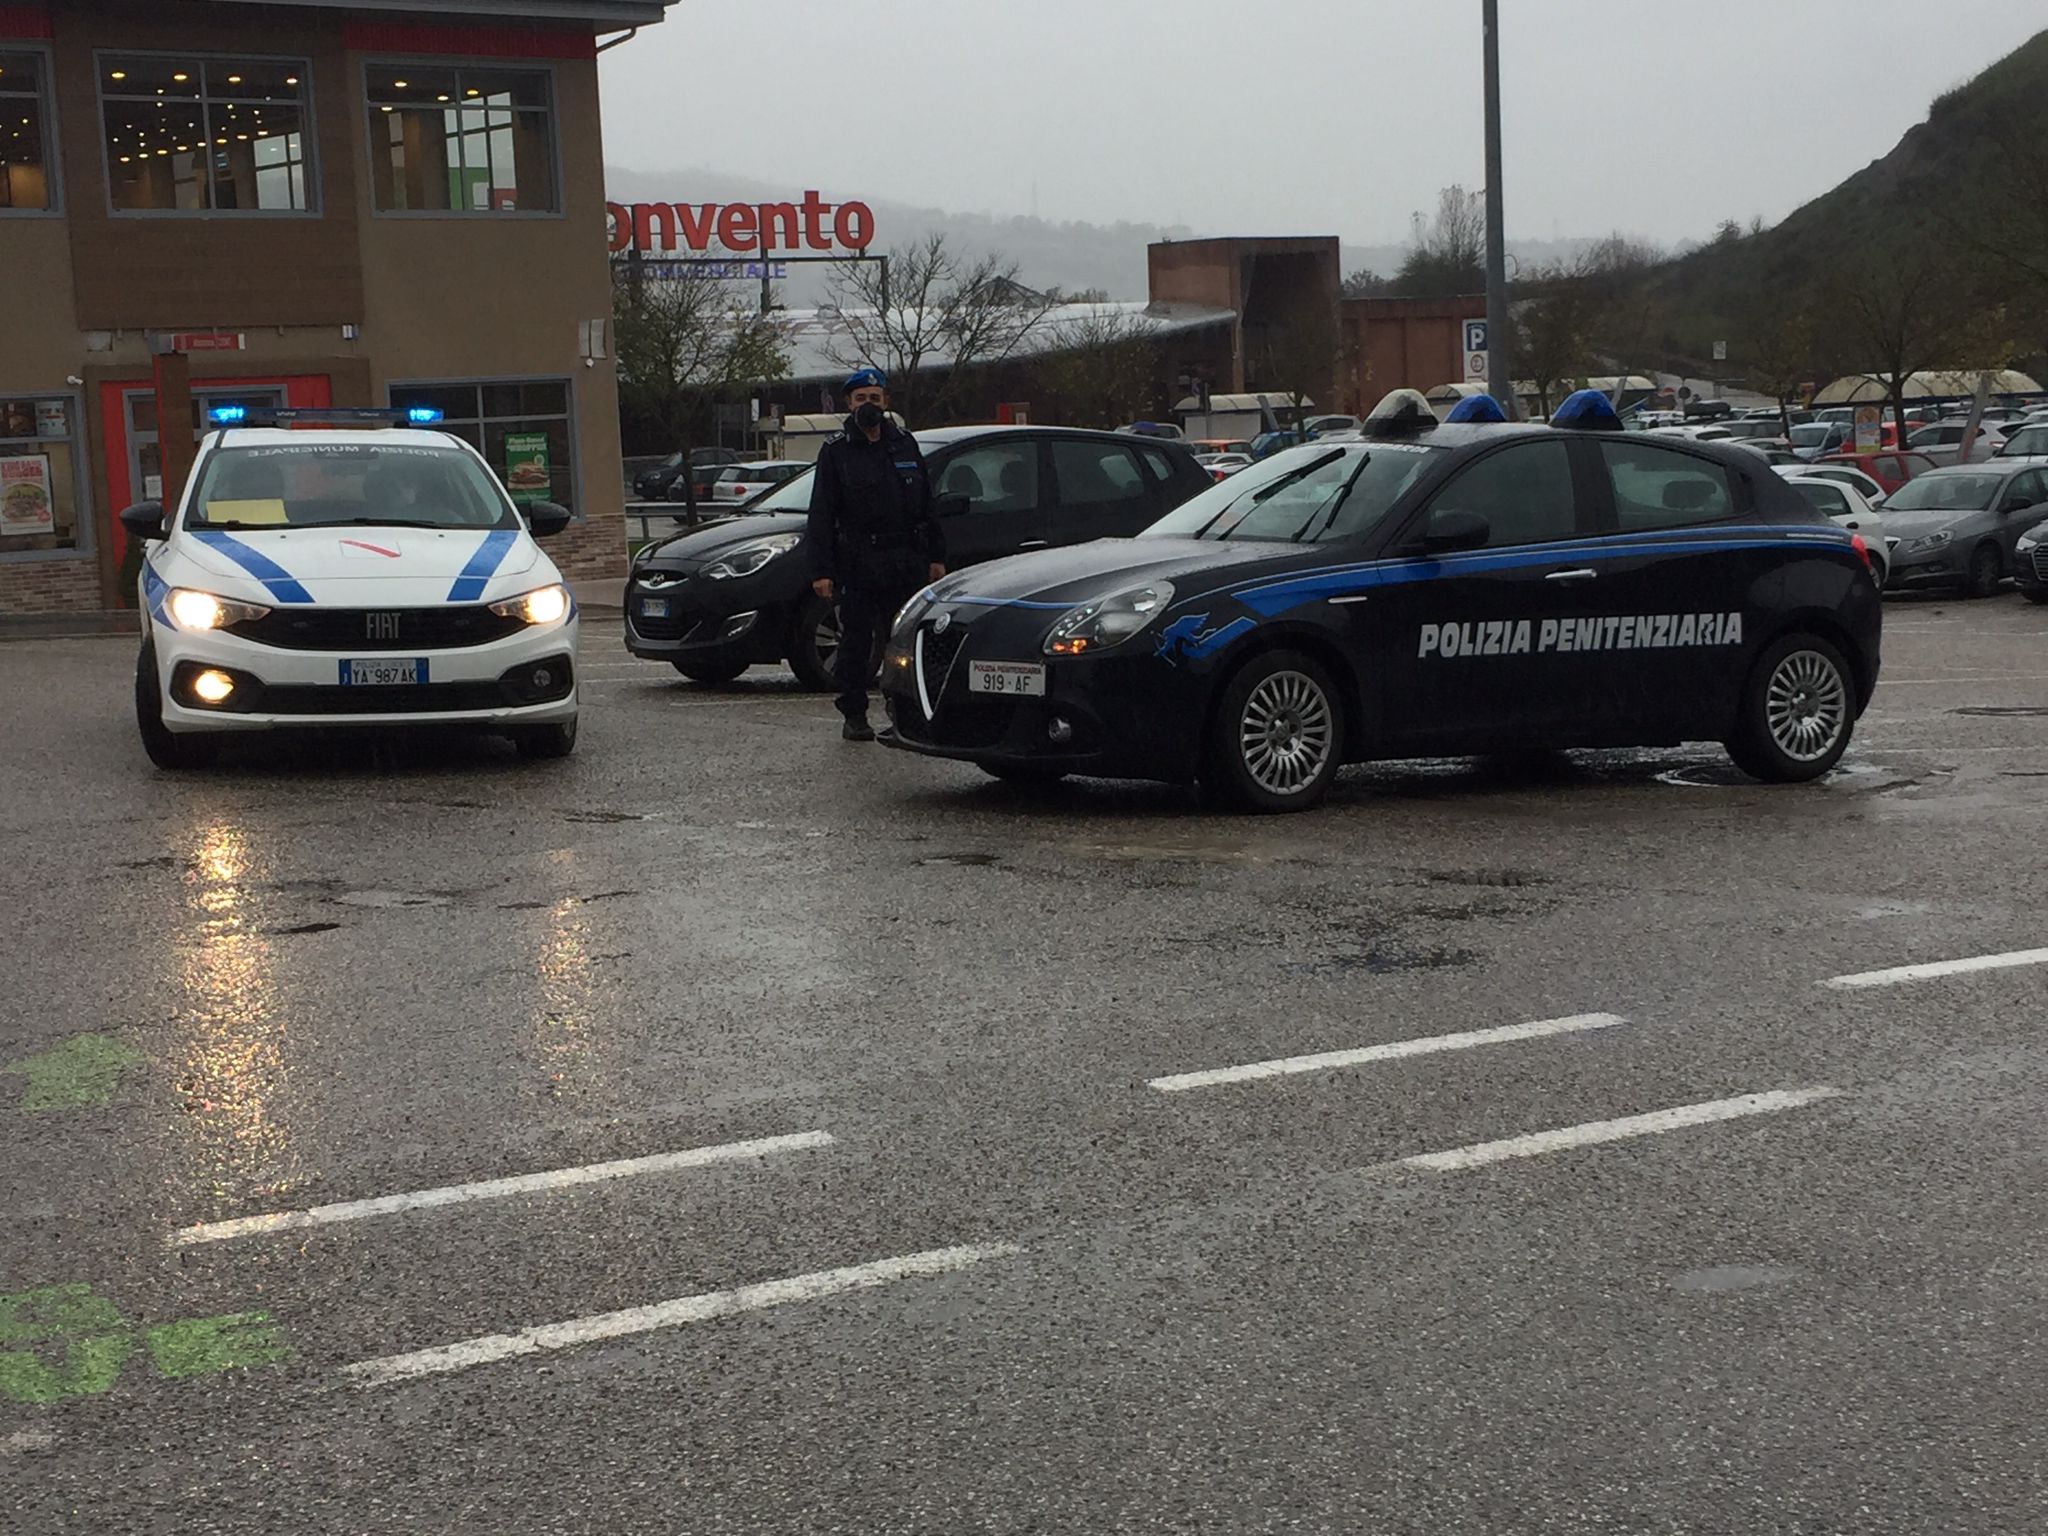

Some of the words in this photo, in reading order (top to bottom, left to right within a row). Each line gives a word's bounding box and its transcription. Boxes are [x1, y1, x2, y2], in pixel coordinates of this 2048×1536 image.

[607, 190, 875, 251] onvento
[1471, 329, 1485, 350] P
[366, 612, 401, 639] FIAT
[1418, 620, 1531, 658] POLIZIA
[1537, 612, 1743, 652] PENITENZIARIA
[374, 668, 399, 683] 987
[983, 673, 1005, 691] 919
[1015, 675, 1031, 692] AF
